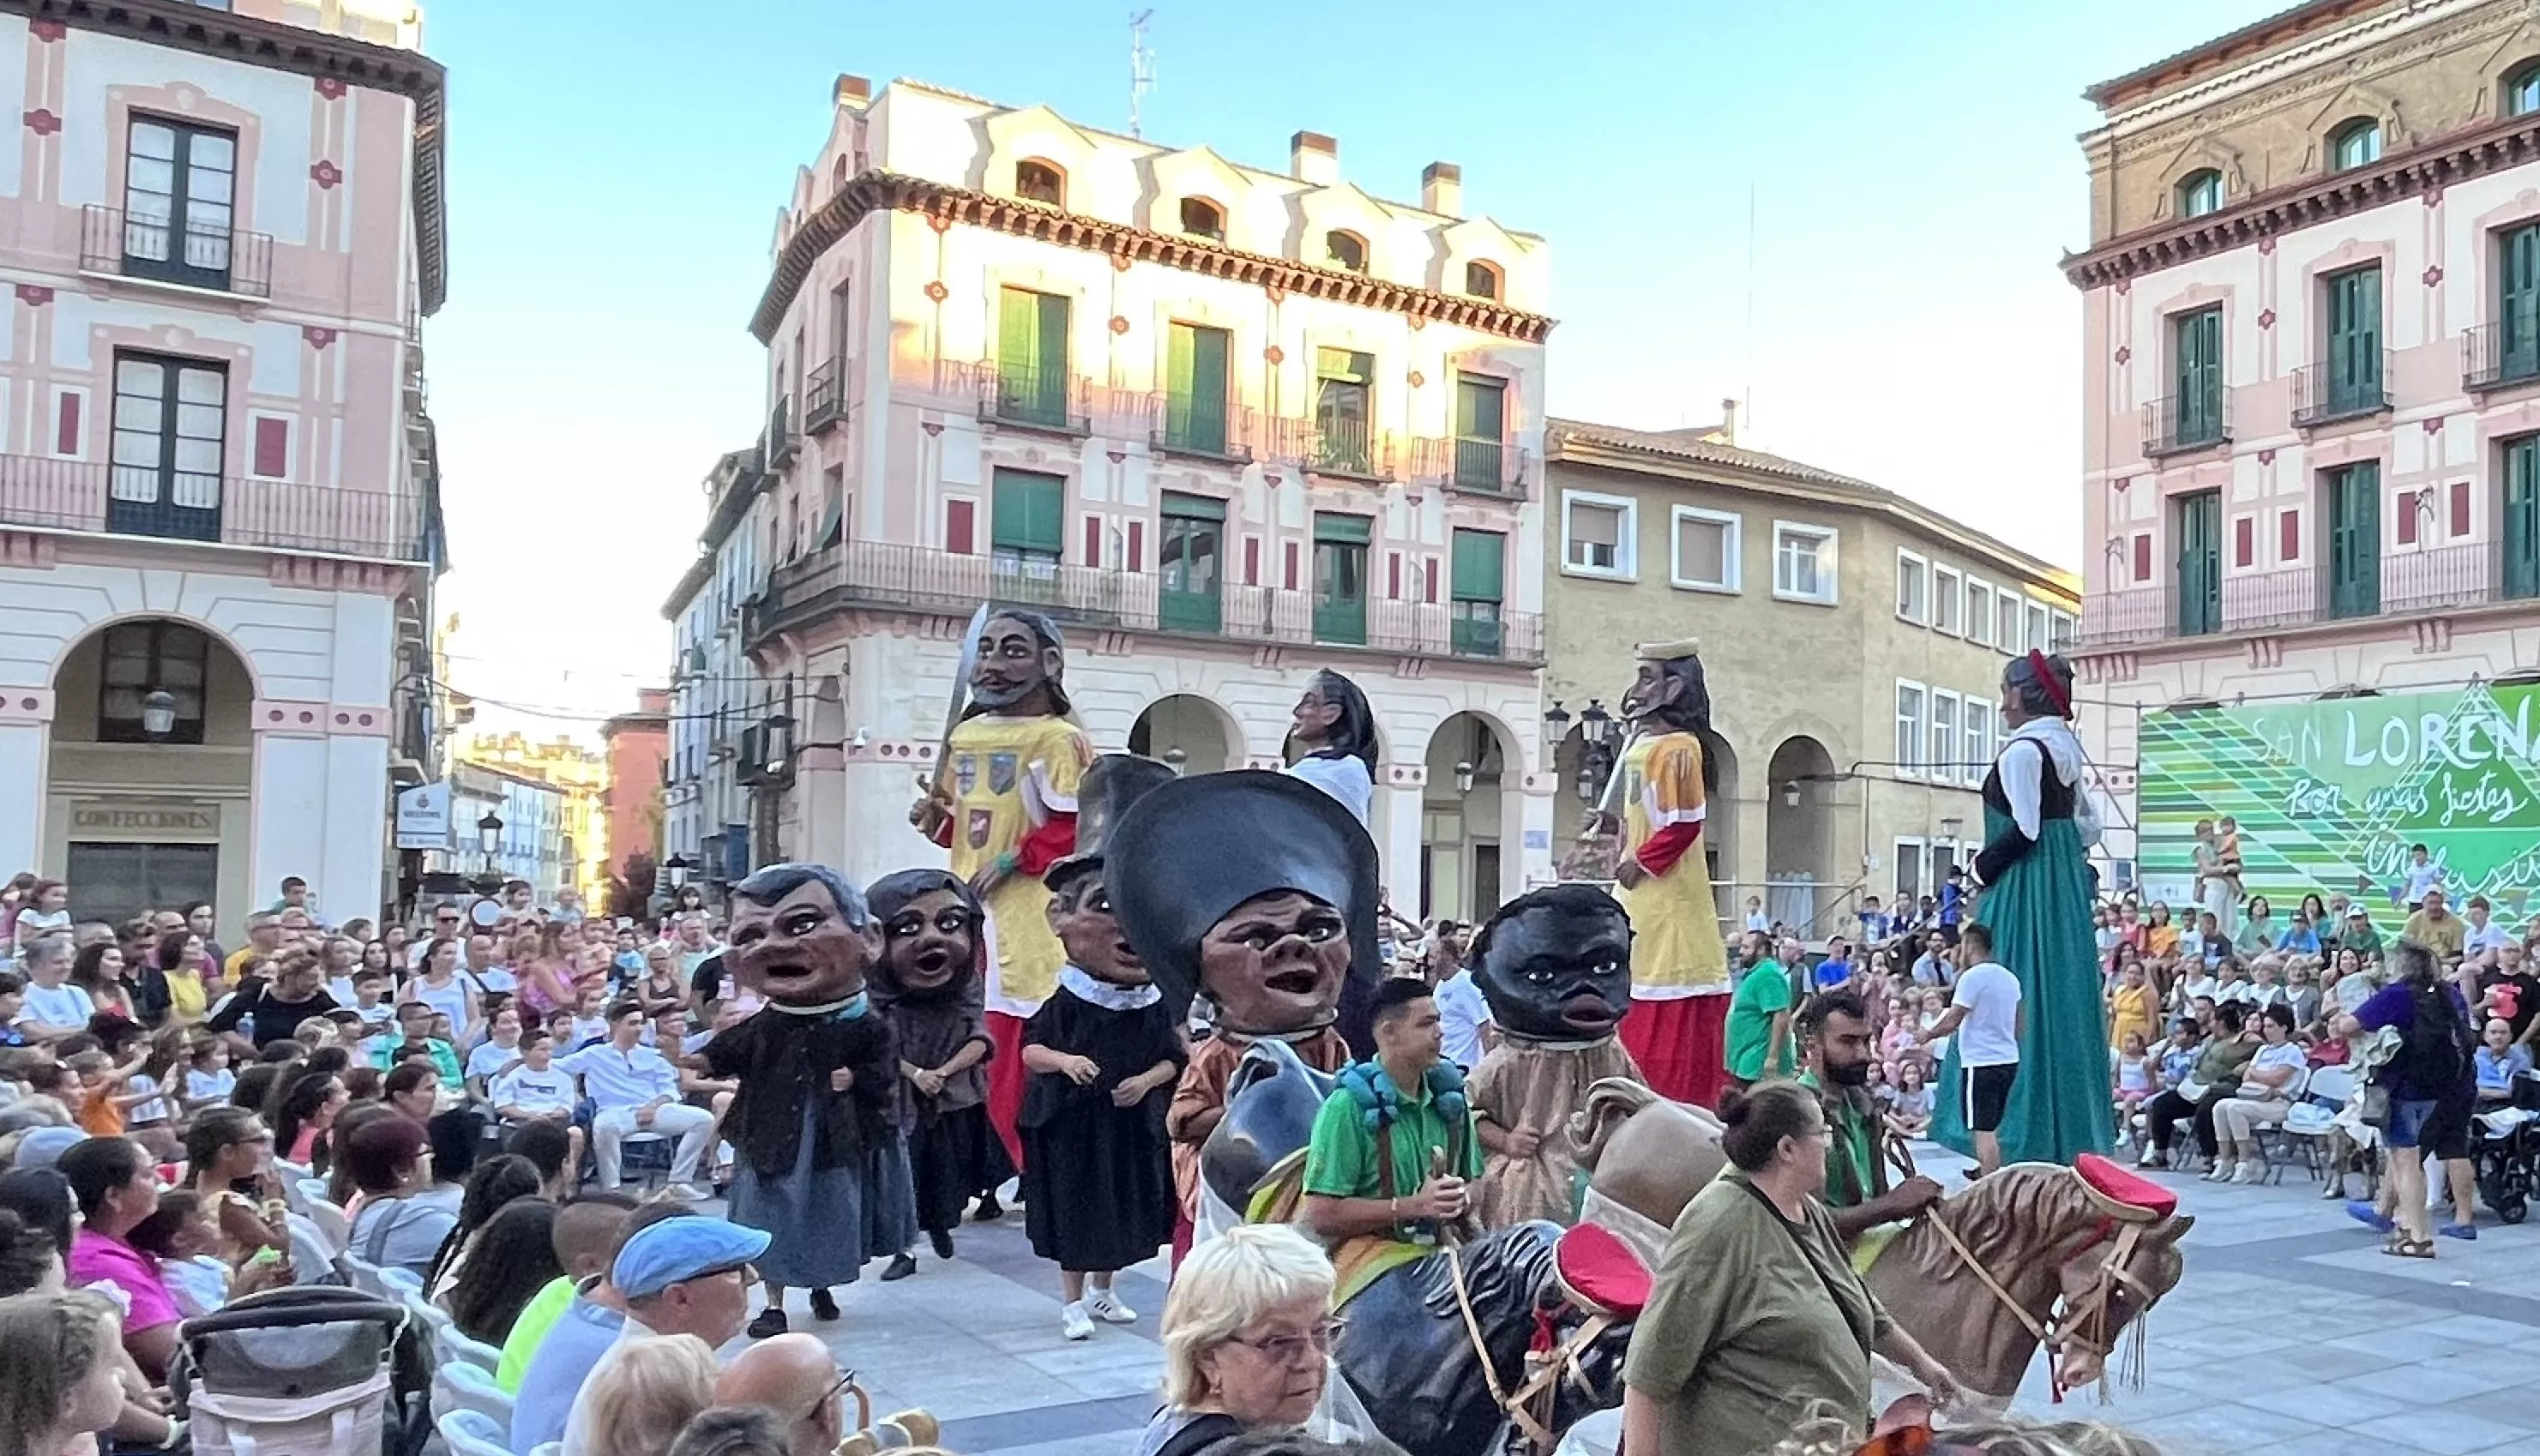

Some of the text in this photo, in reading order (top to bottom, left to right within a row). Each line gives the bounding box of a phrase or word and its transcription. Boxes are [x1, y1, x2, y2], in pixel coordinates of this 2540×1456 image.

[2253, 695, 2540, 769] SAN LOREN
[75, 809, 212, 829] CONFECCIONES
[2440, 769, 2529, 827] fiestas
